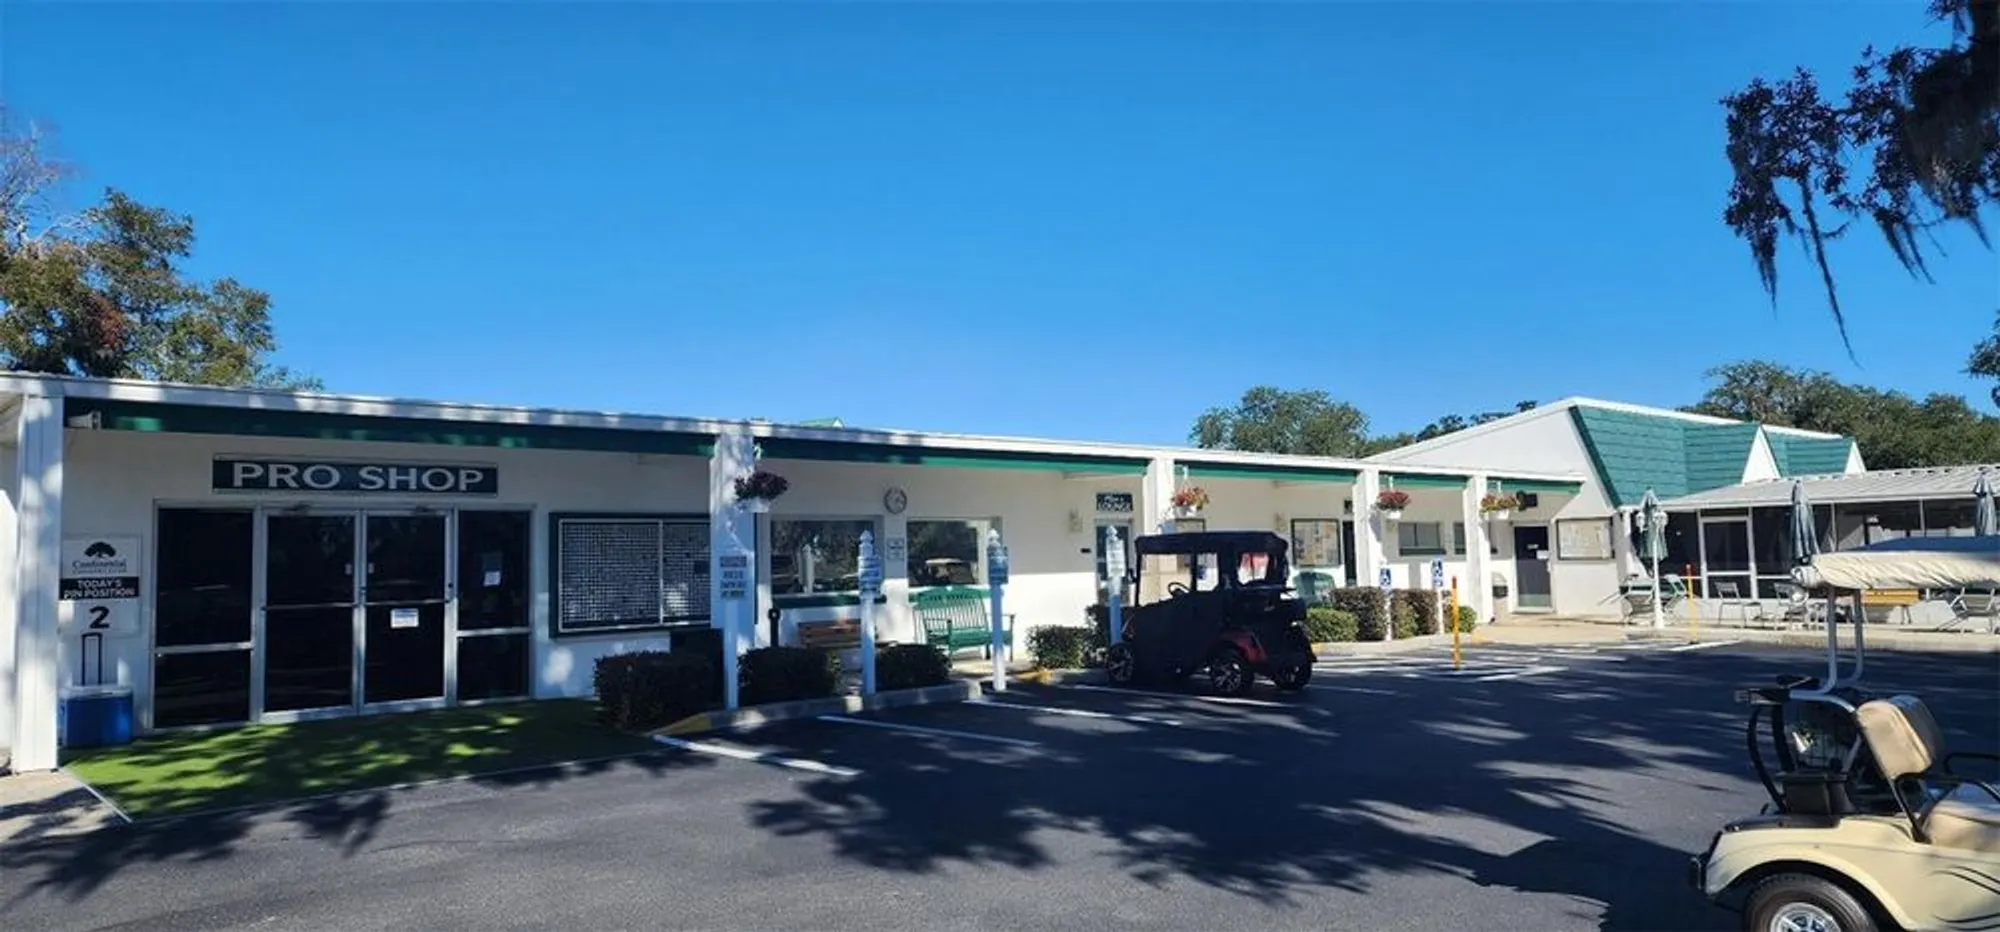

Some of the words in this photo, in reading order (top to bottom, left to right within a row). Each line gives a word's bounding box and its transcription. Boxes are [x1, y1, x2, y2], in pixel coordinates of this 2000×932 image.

[232, 462, 341, 489] PRO
[358, 466, 484, 491] SHOP
[77, 579, 122, 589] TODAY'S
[64, 589, 83, 600] PIN
[84, 588, 135, 598] POSITION
[89, 605, 110, 629] 2
